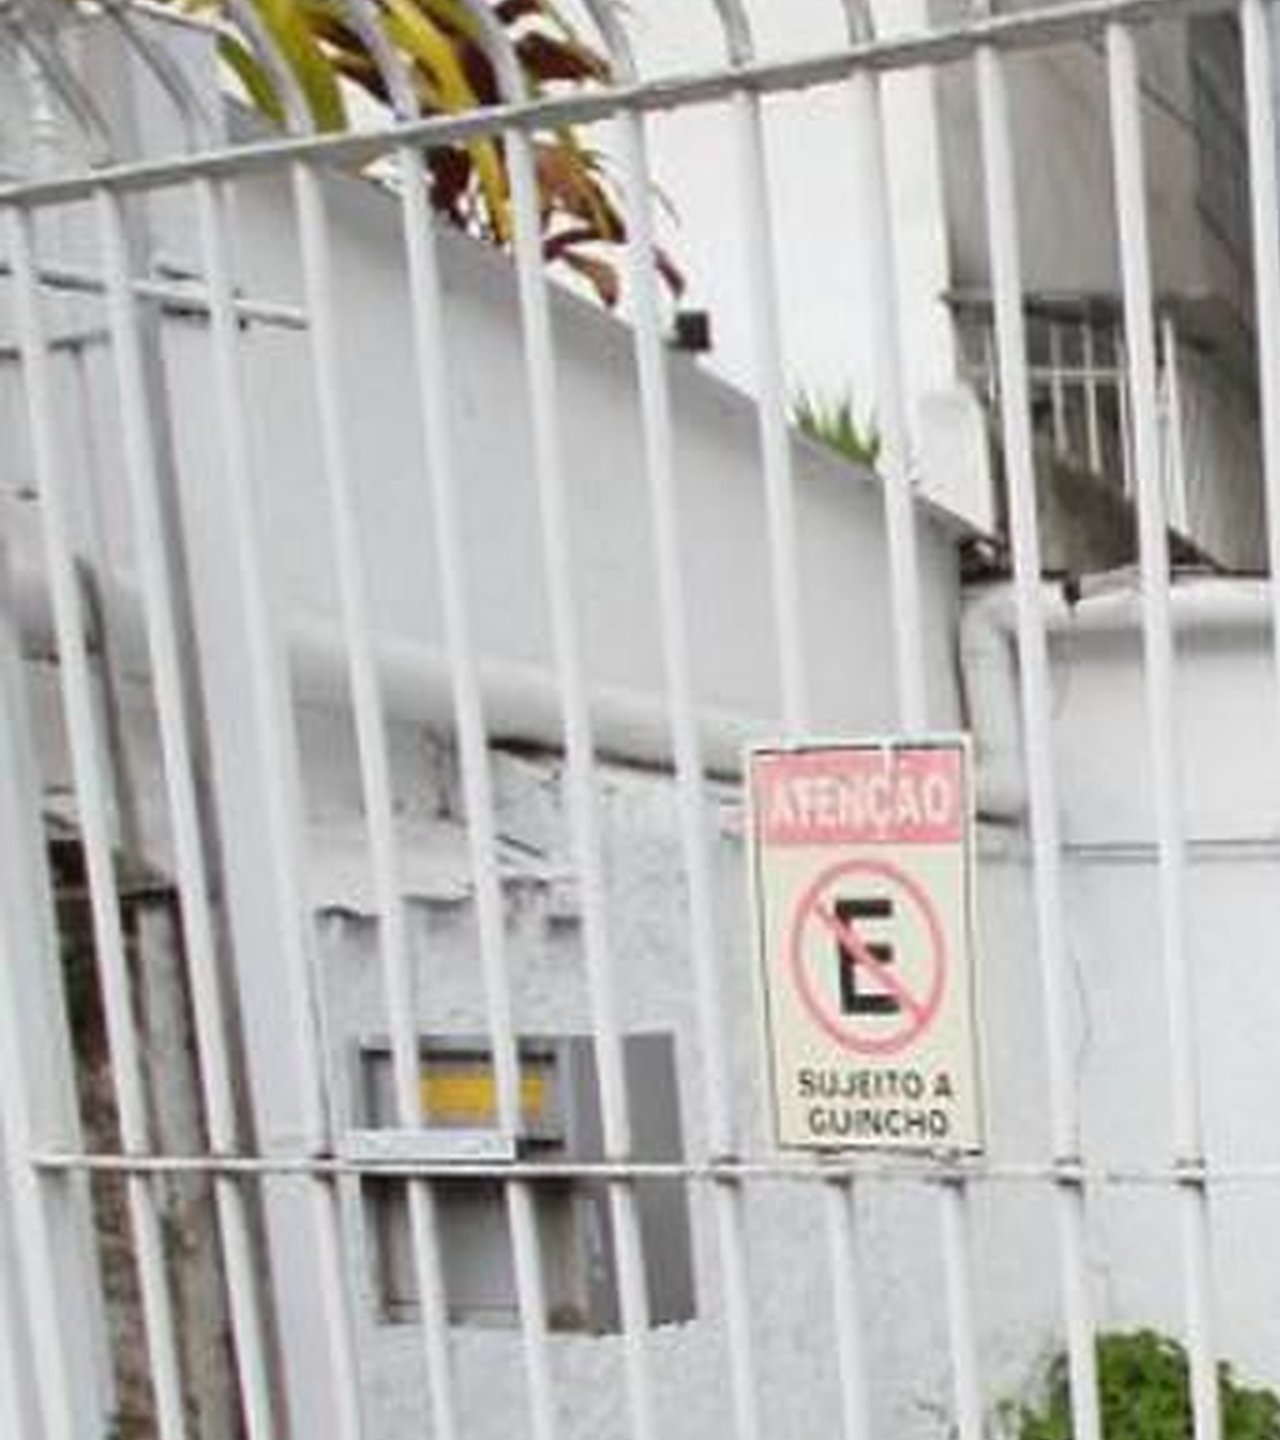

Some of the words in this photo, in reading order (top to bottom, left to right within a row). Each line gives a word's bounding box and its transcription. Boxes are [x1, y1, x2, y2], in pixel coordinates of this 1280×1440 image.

[769, 769, 951, 837] ATENÇÃO
[834, 898, 901, 1016] E
[797, 1068, 926, 1101] SUJEITO
[932, 1070, 953, 1100] A
[807, 1107, 950, 1139] GUINCHO
